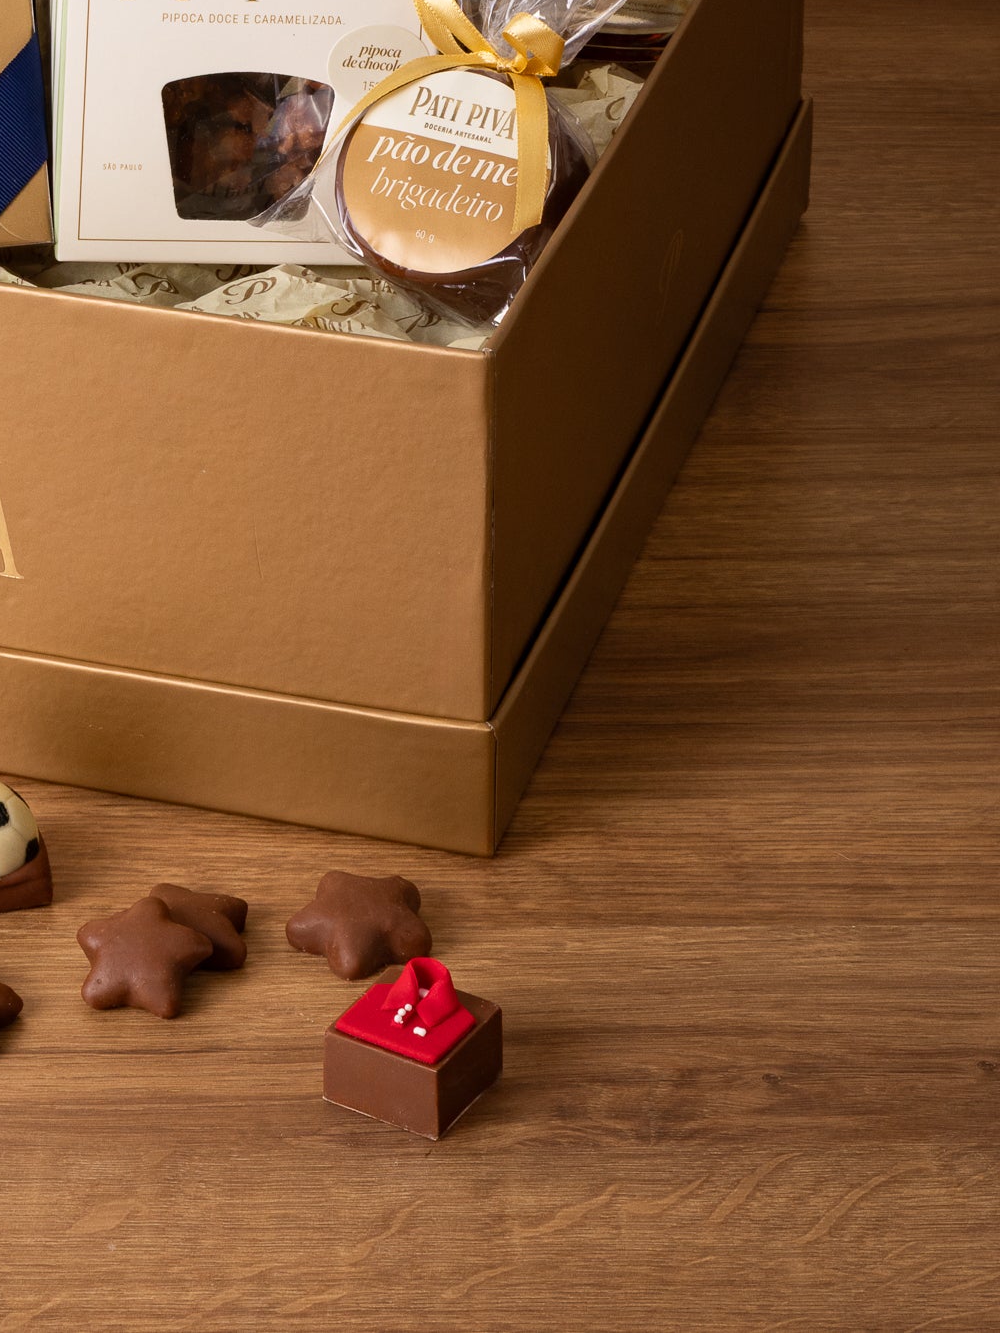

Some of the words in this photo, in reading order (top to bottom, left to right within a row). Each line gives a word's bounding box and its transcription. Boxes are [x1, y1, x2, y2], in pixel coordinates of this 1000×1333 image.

[162, 13, 204, 24] PIPOCA
[208, 13, 239, 24] DOCE
[243, 14, 250, 24] E
[254, 14, 346, 26] CARAMELIZADA.
[359, 44, 402, 59] pipoca
[342, 55, 358, 69] de
[358, 57, 402, 72] chocol
[408, 86, 463, 122] PATI
[465, 103, 518, 141] PIVA
[424, 122, 453, 135] DOCERIA
[454, 129, 493, 144] ARTESANAL
[102, 162, 117, 171] SÃO
[120, 163, 143, 171] PAULO
[366, 135, 431, 163] pão
[432, 144, 471, 175] de
[471, 158, 519, 187] me
[370, 166, 504, 223] brigadeiro
[415, 229, 426, 240] 60
[428, 233, 435, 244] g
